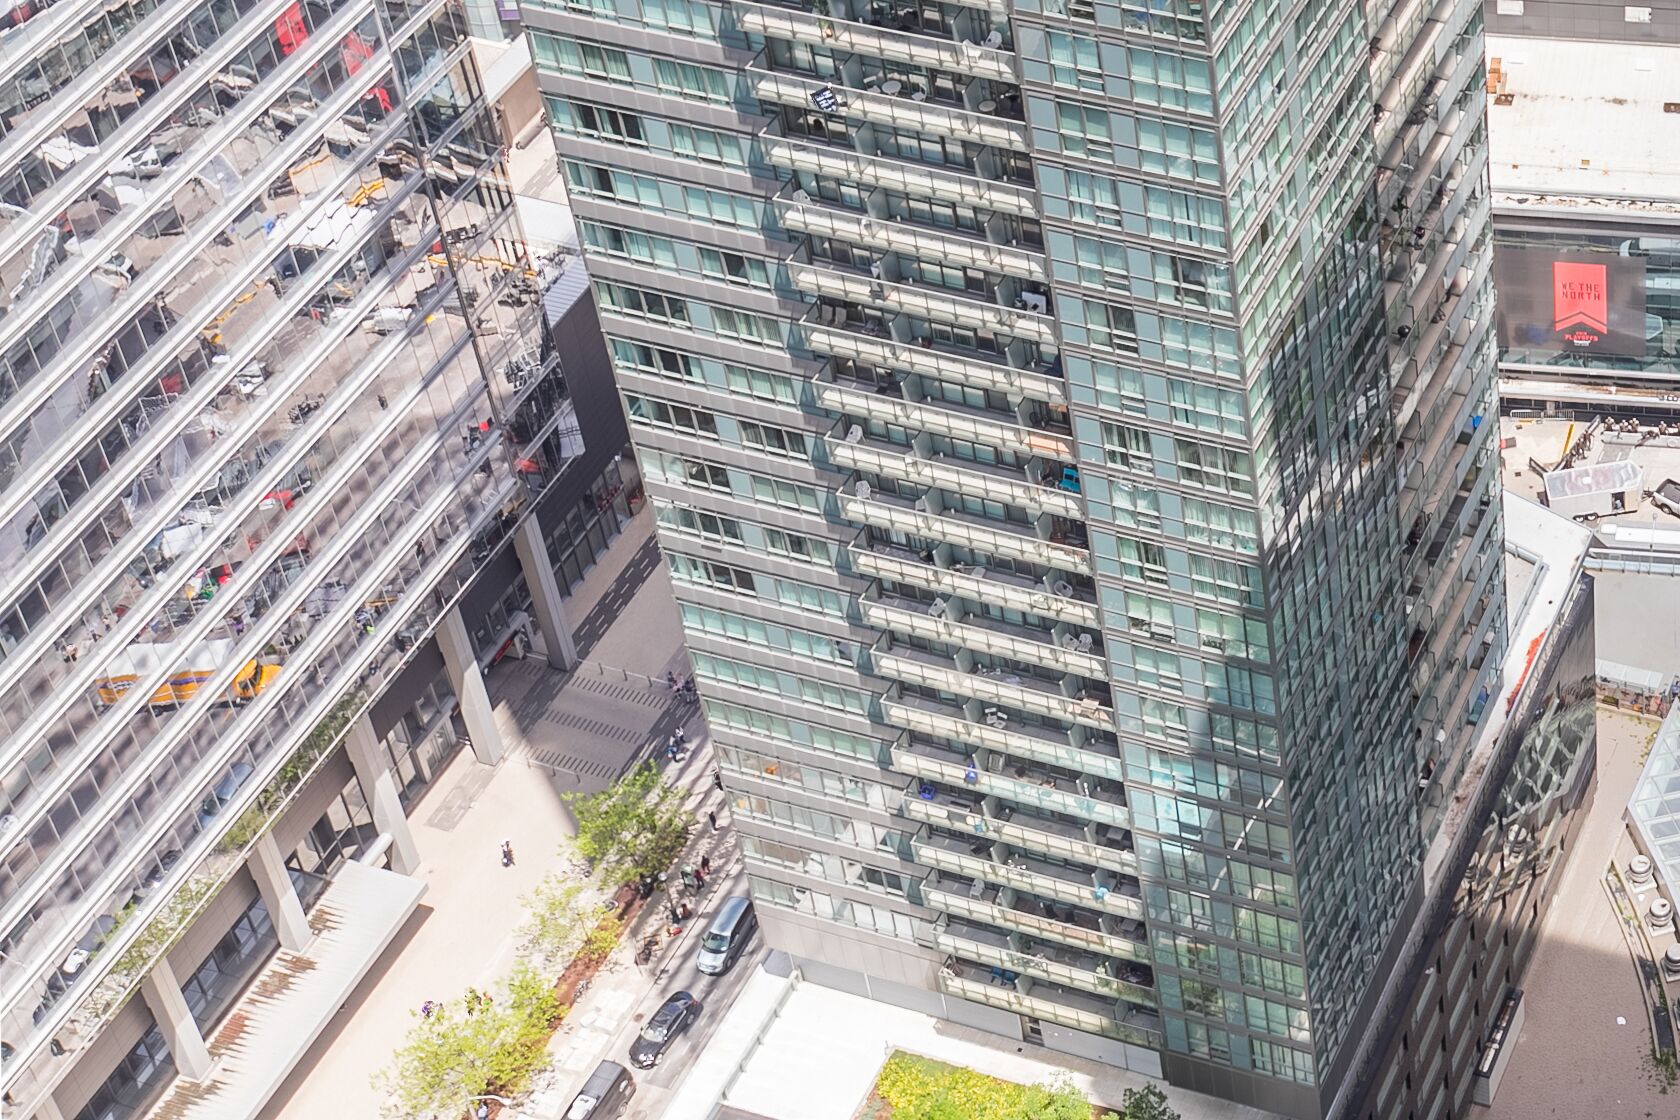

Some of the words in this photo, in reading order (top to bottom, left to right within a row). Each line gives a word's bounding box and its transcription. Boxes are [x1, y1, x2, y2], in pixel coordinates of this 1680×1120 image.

[1561, 281, 1575, 291] WE
[1578, 282, 1600, 292] THE
[1562, 291, 1600, 301] NORTH
